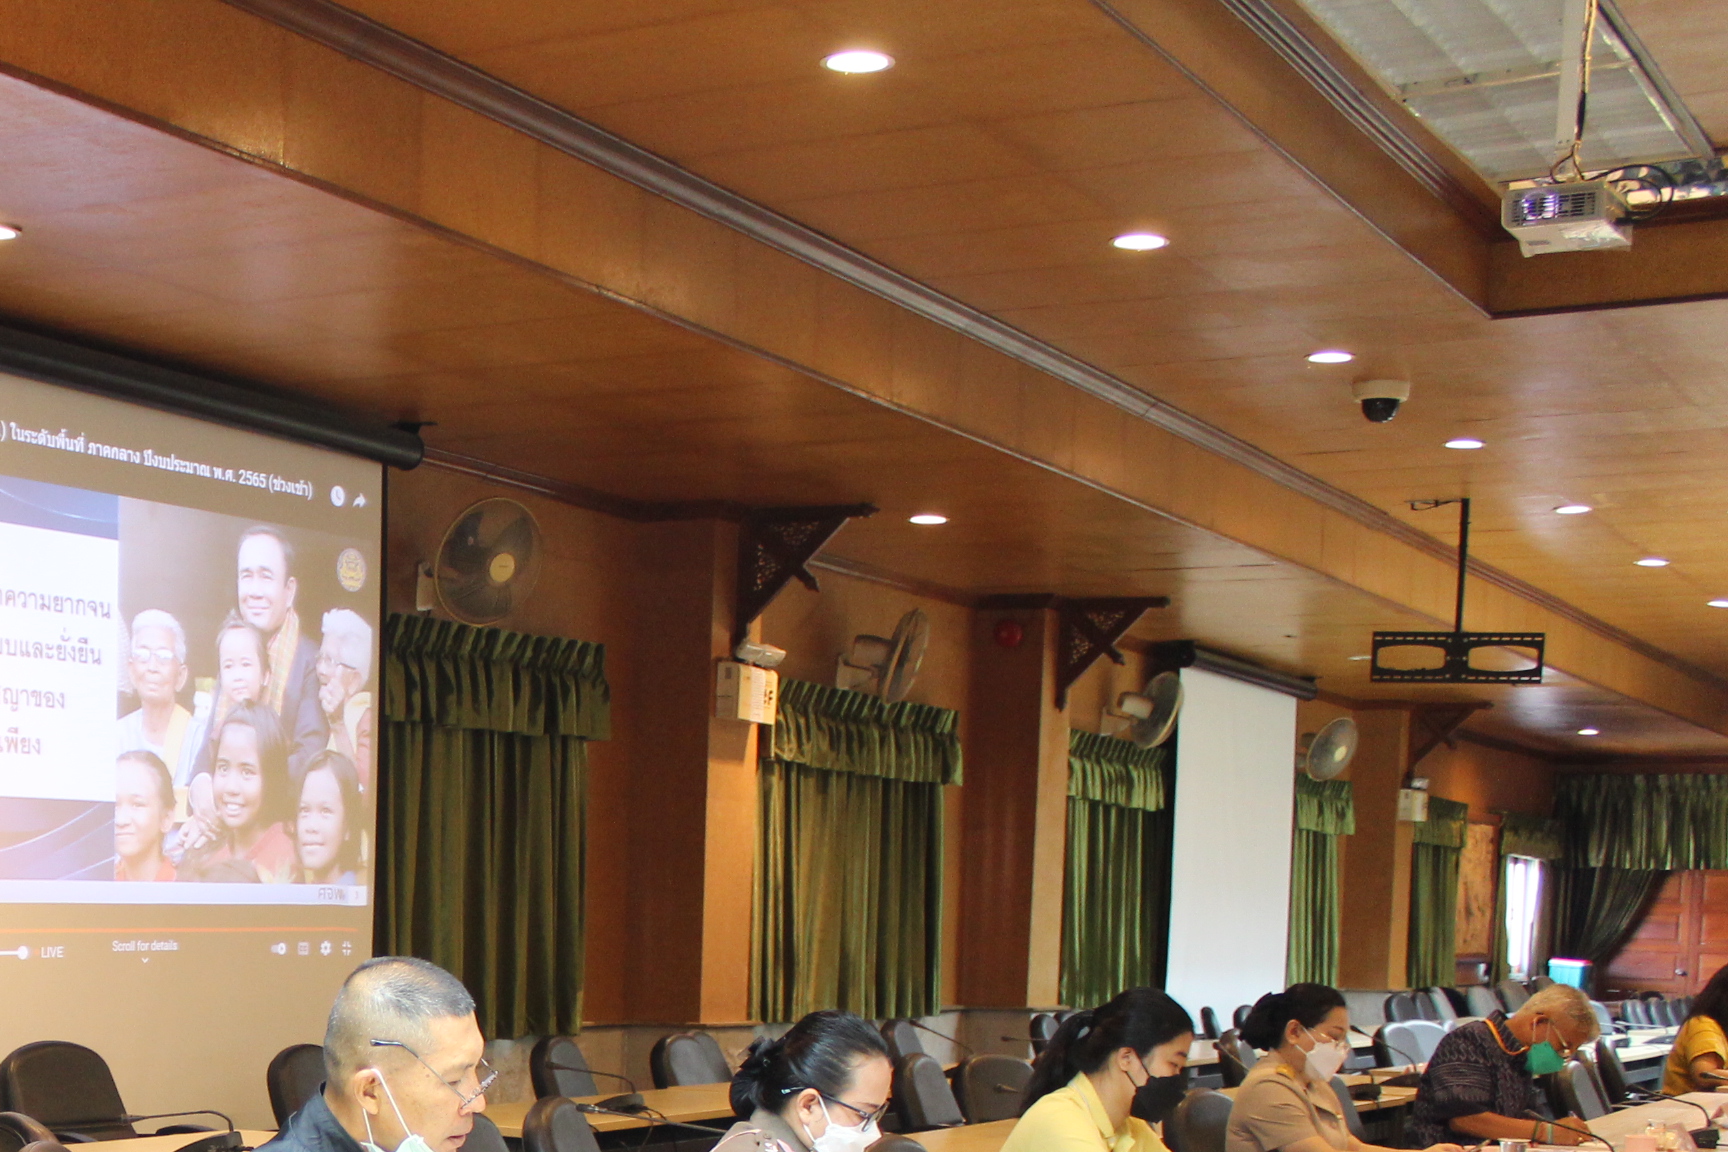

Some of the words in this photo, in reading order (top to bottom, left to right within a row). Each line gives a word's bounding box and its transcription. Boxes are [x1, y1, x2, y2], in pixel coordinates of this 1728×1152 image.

[9, 421, 86, 453] ในระดับพื้นที่
[87, 441, 141, 464] ภาคกลาง
[143, 448, 211, 478] ปีงบประมาณ
[213, 466, 237, 483] พ.ศ.
[238, 469, 267, 489] 2565
[268, 474, 313, 501] (ช่วงเช้า)
[112, 940, 136, 952] Scroll
[137, 940, 150, 952] for
[150, 939, 178, 951] details
[40, 946, 65, 959] LIVE
